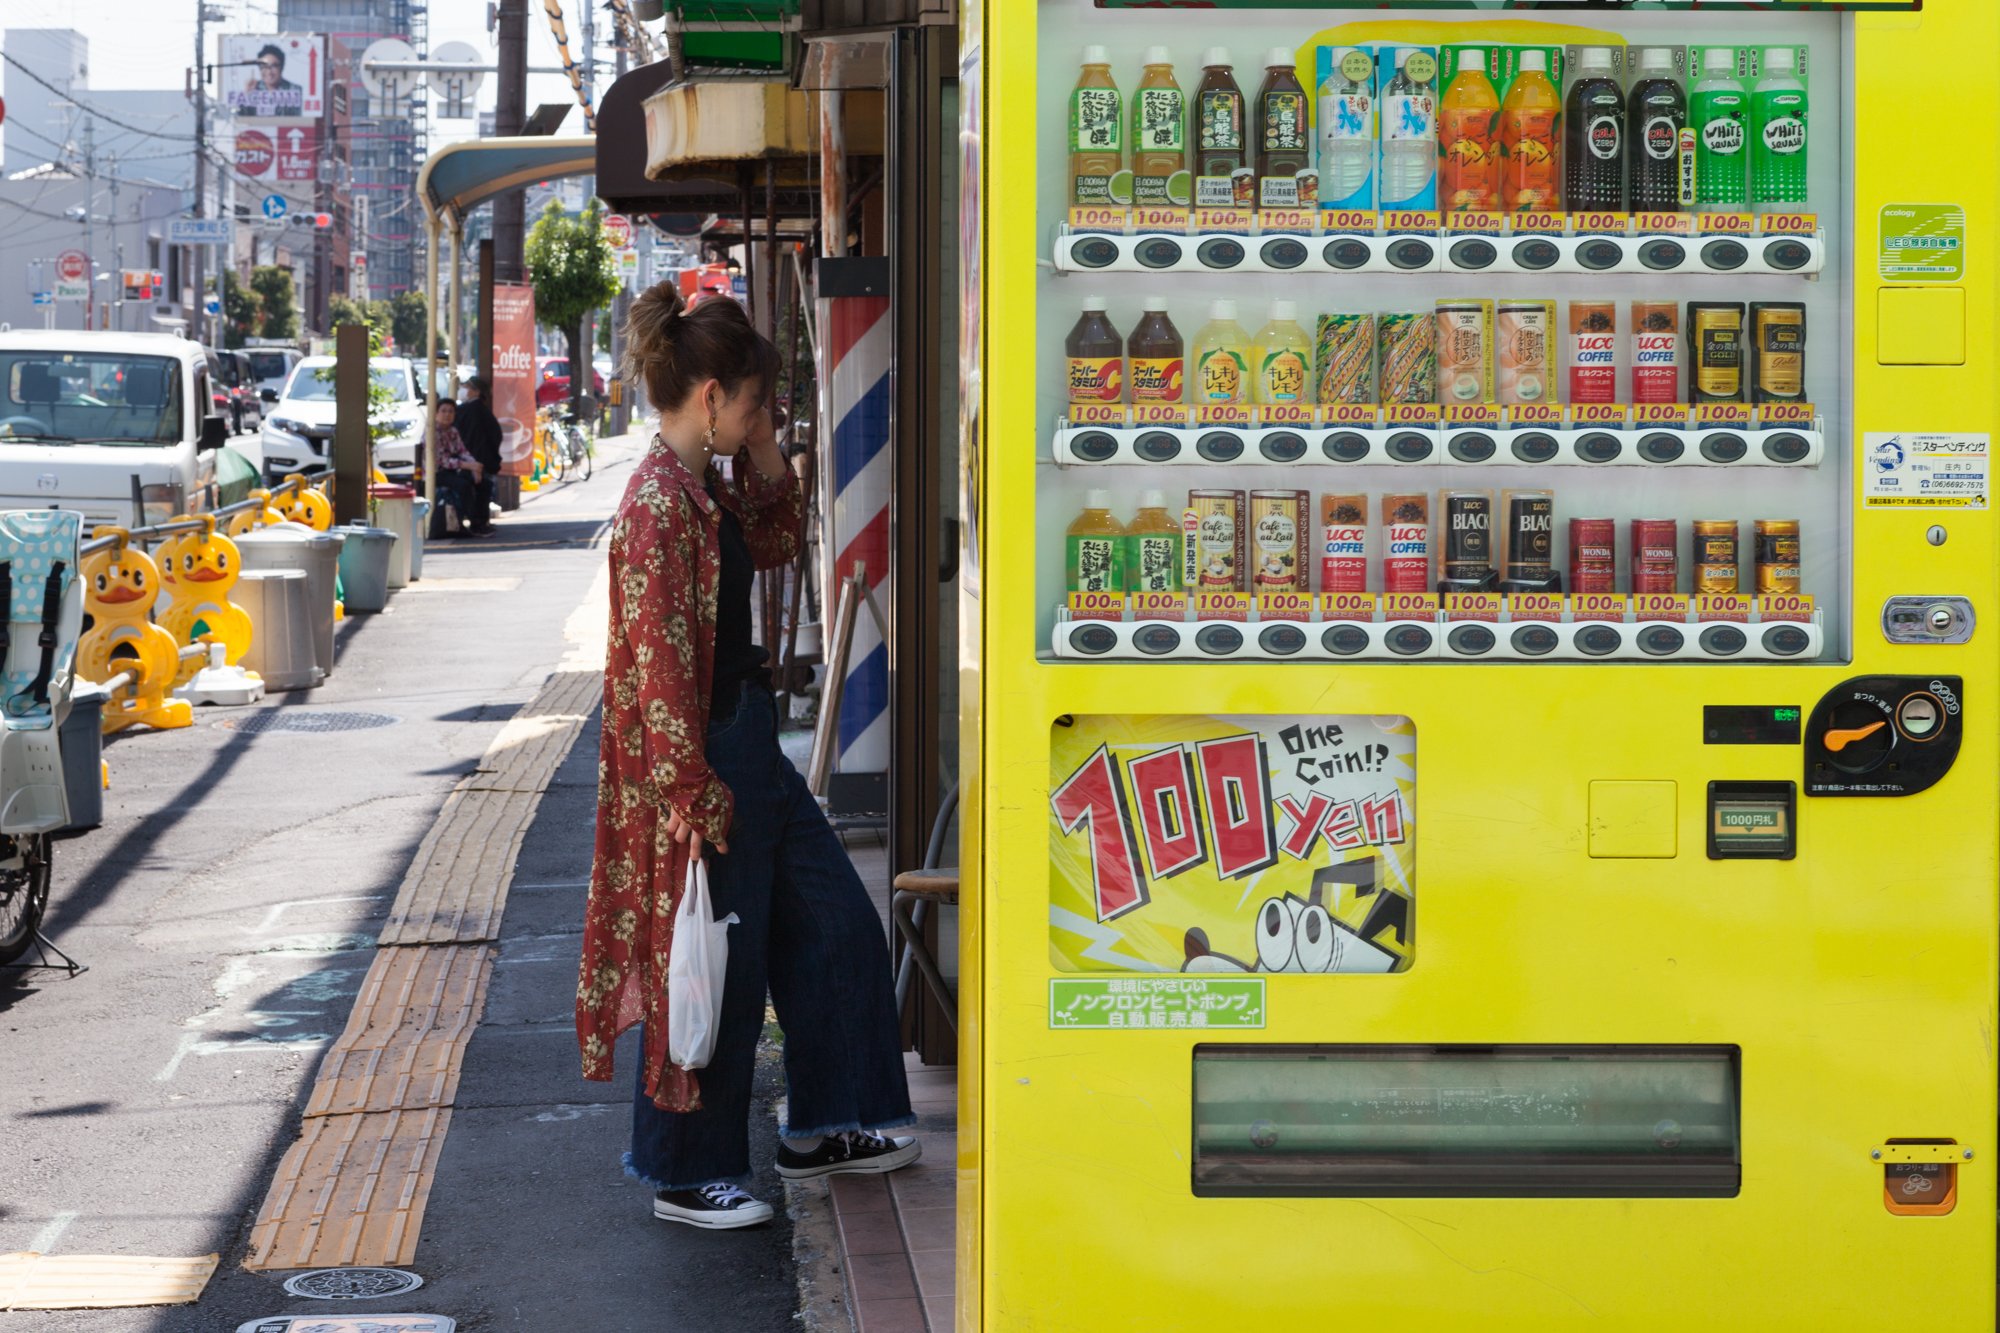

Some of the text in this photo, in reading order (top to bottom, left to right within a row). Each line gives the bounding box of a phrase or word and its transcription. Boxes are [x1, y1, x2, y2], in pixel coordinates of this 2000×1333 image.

[1592, 128, 1616, 140] COLA
[1648, 128, 1674, 140] COLA
[1651, 140, 1671, 148] ZERO
[1710, 138, 1740, 150] SQUASH
[1771, 138, 1802, 150] SQUASH
[235, 150, 271, 164] ガスト
[1449, 148, 1496, 168] オレンジ
[1512, 148, 1558, 168] オレンジ
[1682, 154, 1692, 200] おすすめ
[1076, 210, 1122, 224] 100円
[1138, 211, 1185, 225] 100円
[1202, 211, 1248, 225] 100円
[1264, 212, 1311, 226] 100円
[1328, 212, 1374, 226] 100円
[1390, 213, 1437, 227] 100円
[1452, 213, 1499, 227] 100円
[1884, 209, 1916, 218] ecology
[1516, 214, 1562, 228] 100円
[1578, 214, 1624, 228] 100円
[1640, 215, 1687, 229] 100円
[1704, 215, 1750, 229] 100円
[1766, 215, 1812, 229] 100円
[1886, 238, 1958, 248] LED照明自販機
[1462, 330, 1470, 362] 仕立ての
[1578, 337, 1614, 350] UCC
[1638, 337, 1674, 350] UCC
[492, 345, 532, 371] Coffee
[1578, 352, 1614, 362] COFFEE
[1638, 352, 1674, 362] COFFEE
[1070, 365, 1098, 376] スーパー
[1133, 366, 1162, 377] スーパー
[1203, 366, 1238, 381] キレキレ
[1268, 366, 1303, 382] キレキレ
[1070, 376, 1106, 388] スタミロン
[1134, 377, 1168, 388] スタミロン
[1206, 378, 1236, 392] レモン
[1272, 379, 1301, 394] レモン
[1076, 406, 1122, 421] 100円
[1138, 406, 1186, 421] 100円
[1201, 406, 1248, 421] 100円
[1264, 406, 1311, 421] 100円
[1327, 406, 1374, 421] 100円
[1390, 406, 1437, 421] 100円
[1452, 406, 1499, 421] 100円
[1514, 406, 1562, 421] 100円
[1576, 406, 1623, 421] 100円
[1638, 406, 1686, 421] 100円
[1701, 406, 1748, 420] 100円
[1764, 406, 1810, 420] 100円
[1874, 446, 1891, 454] Star
[1922, 442, 1986, 452] スターベンディング
[1868, 456, 1902, 465] Vending
[1931, 481, 1984, 489] (06)6692-7575
[1463, 502, 1482, 510] UCC
[1532, 502, 1550, 511] UCC
[1452, 513, 1490, 530] BLACK
[1216, 532, 1234, 542] Lait
[1274, 532, 1293, 542] Lait
[1326, 529, 1364, 541] UCC
[1390, 528, 1427, 541] UCC
[1326, 542, 1364, 553] COFFEE
[1390, 542, 1426, 553] COFFEE
[1582, 548, 1611, 556] WONDA
[1644, 549, 1673, 557] WONDA
[1186, 534, 1196, 580] 新発売
[1327, 560, 1364, 568] ミルクコーヒー
[1074, 594, 1122, 609] 100円
[1138, 594, 1185, 609] 100円
[1200, 595, 1247, 609] 100円
[1263, 595, 1310, 609] 100円
[1326, 595, 1373, 610] 100円
[1388, 595, 1436, 610] 100円
[1452, 595, 1499, 610] 100円
[1514, 596, 1561, 610] 100円
[1576, 596, 1624, 610] 100円
[1639, 596, 1686, 610] 100円
[1702, 596, 1749, 611] 100円
[1764, 596, 1811, 611] 100円
[1854, 692, 1892, 714] おつり・返却
[1774, 708, 1800, 722] 販売中
[1278, 723, 1344, 755] One
[1296, 743, 1389, 786] Coin!?
[1725, 814, 1774, 825] 1000円札
[1050, 732, 1406, 924] 100 yen
[1108, 978, 1208, 993] 環境にやさしい
[1066, 994, 1249, 1011] ノンフロンヒートポンプ
[1108, 1010, 1208, 1028] 自動販売機
